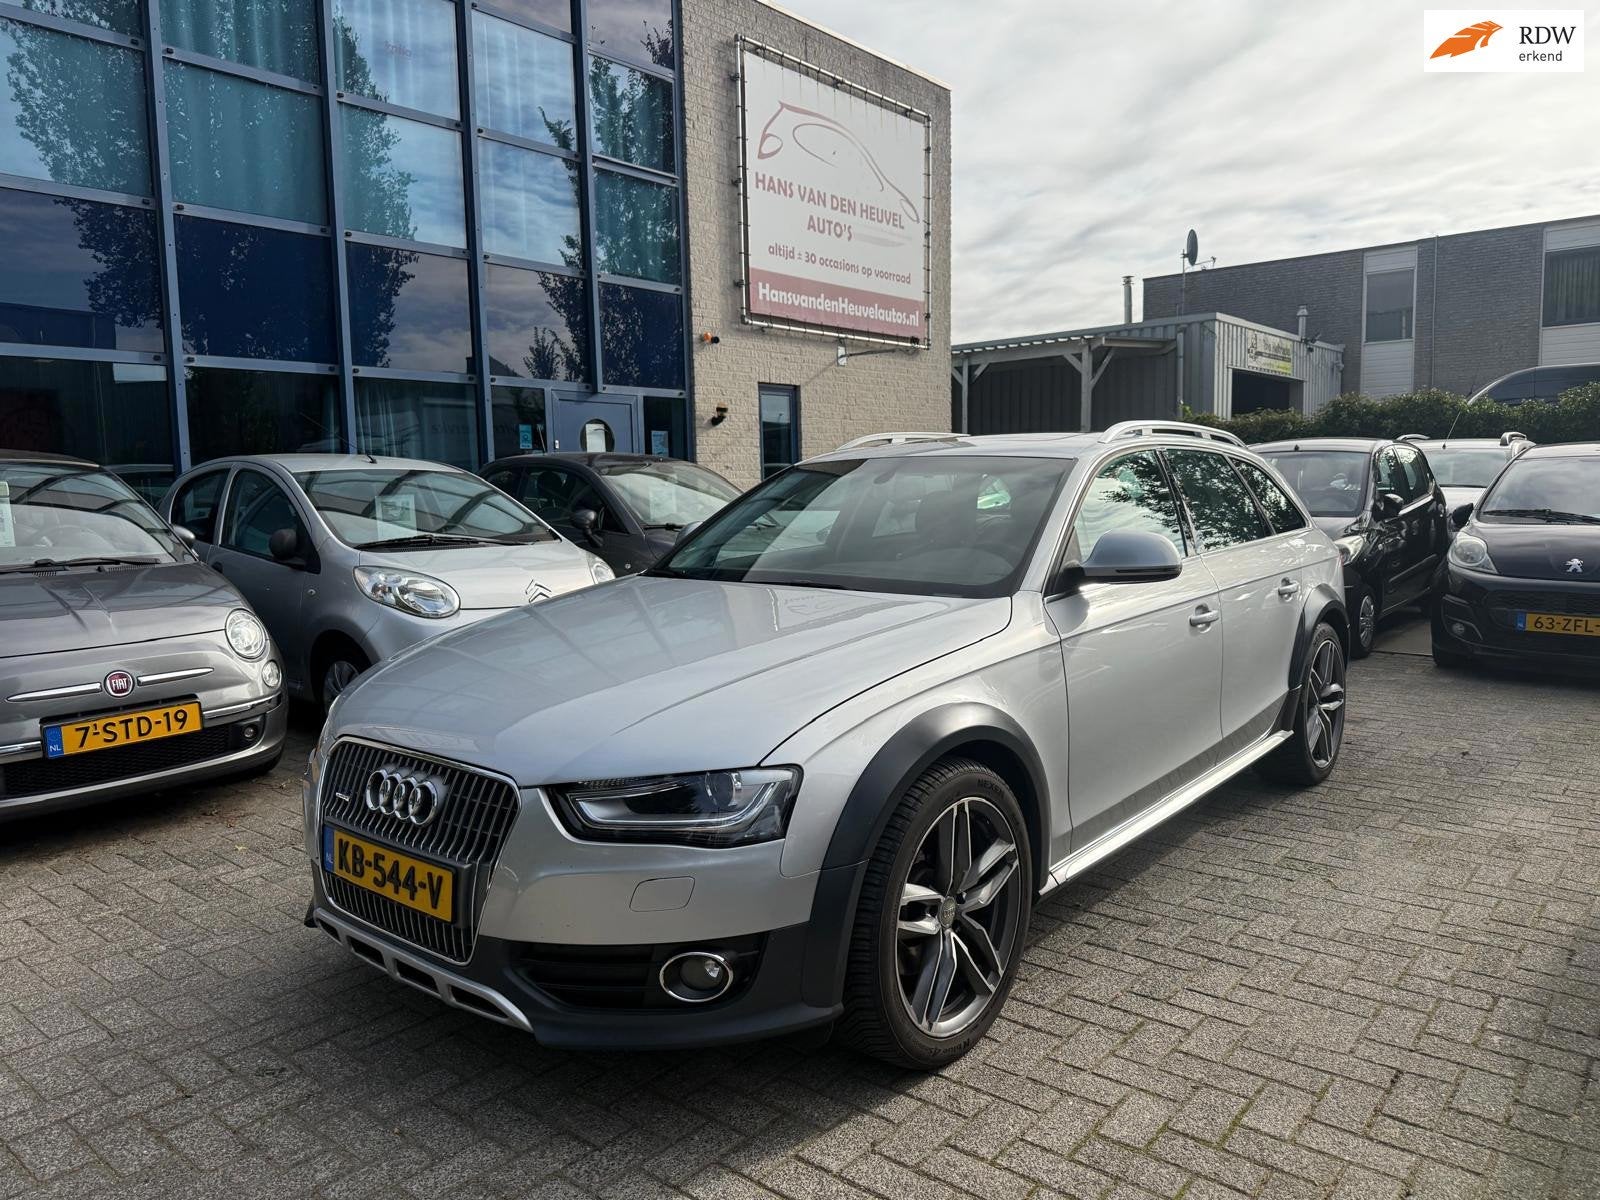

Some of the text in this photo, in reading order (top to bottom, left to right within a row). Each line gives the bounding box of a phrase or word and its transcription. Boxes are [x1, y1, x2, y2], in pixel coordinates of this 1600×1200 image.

[755, 171, 905, 229] HANS VAN DEN HEUVEL
[807, 214, 853, 241] AUTO'S
[768, 242, 795, 260] altijd
[804, 251, 817, 264] 30
[818, 256, 860, 274] occasions
[861, 265, 873, 278] op
[874, 267, 912, 285] voorraad
[758, 281, 919, 327] HansvandenHeuvelautos.nl
[111, 678, 128, 691] FIAT
[50, 744, 61, 752] NL
[338, 838, 443, 910] KB-544-V
